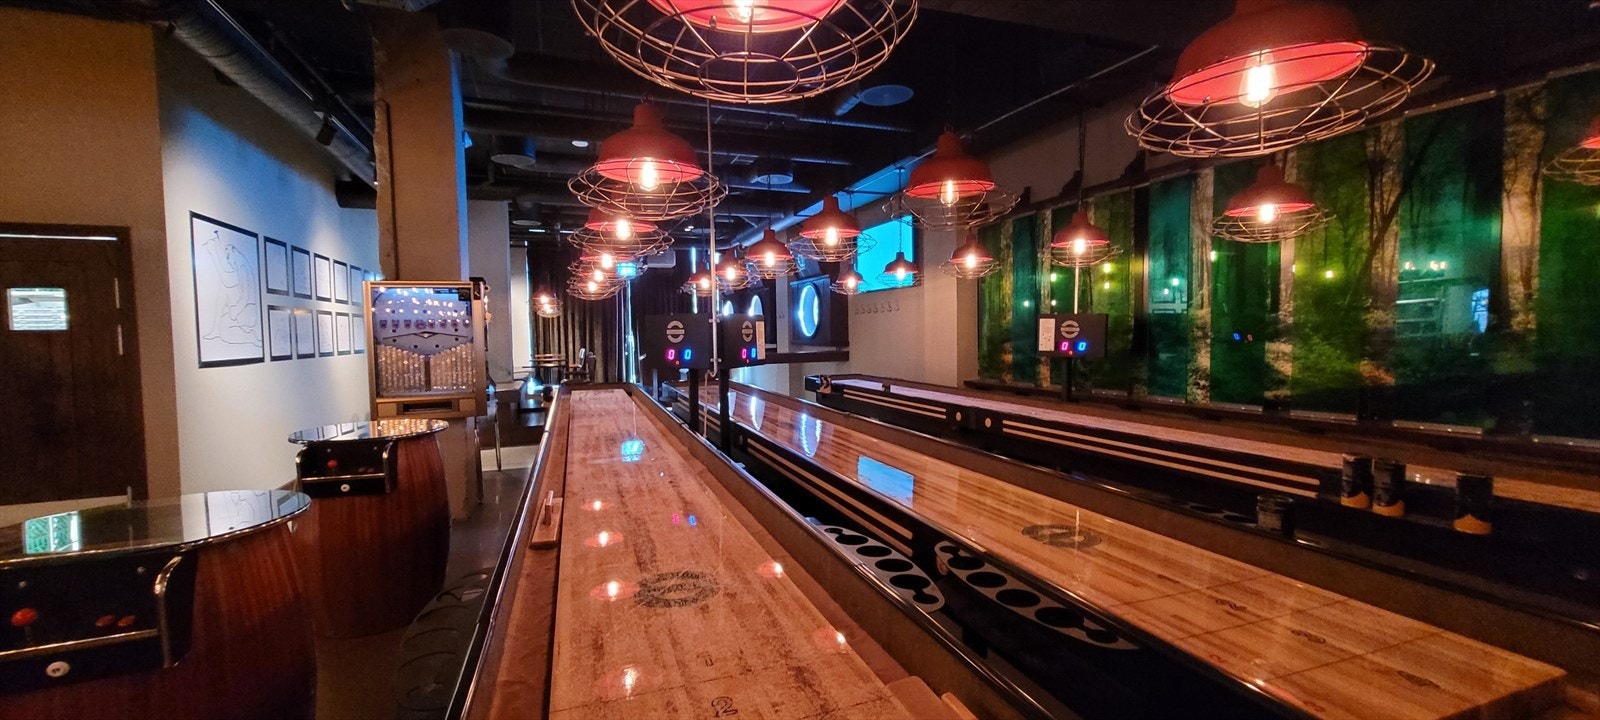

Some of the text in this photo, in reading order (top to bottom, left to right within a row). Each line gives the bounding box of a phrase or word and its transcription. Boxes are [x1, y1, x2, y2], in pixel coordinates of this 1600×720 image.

[1061, 341, 1087, 351] 0 0
[667, 349, 692, 360] 0 0
[741, 347, 757, 359] 0 0
